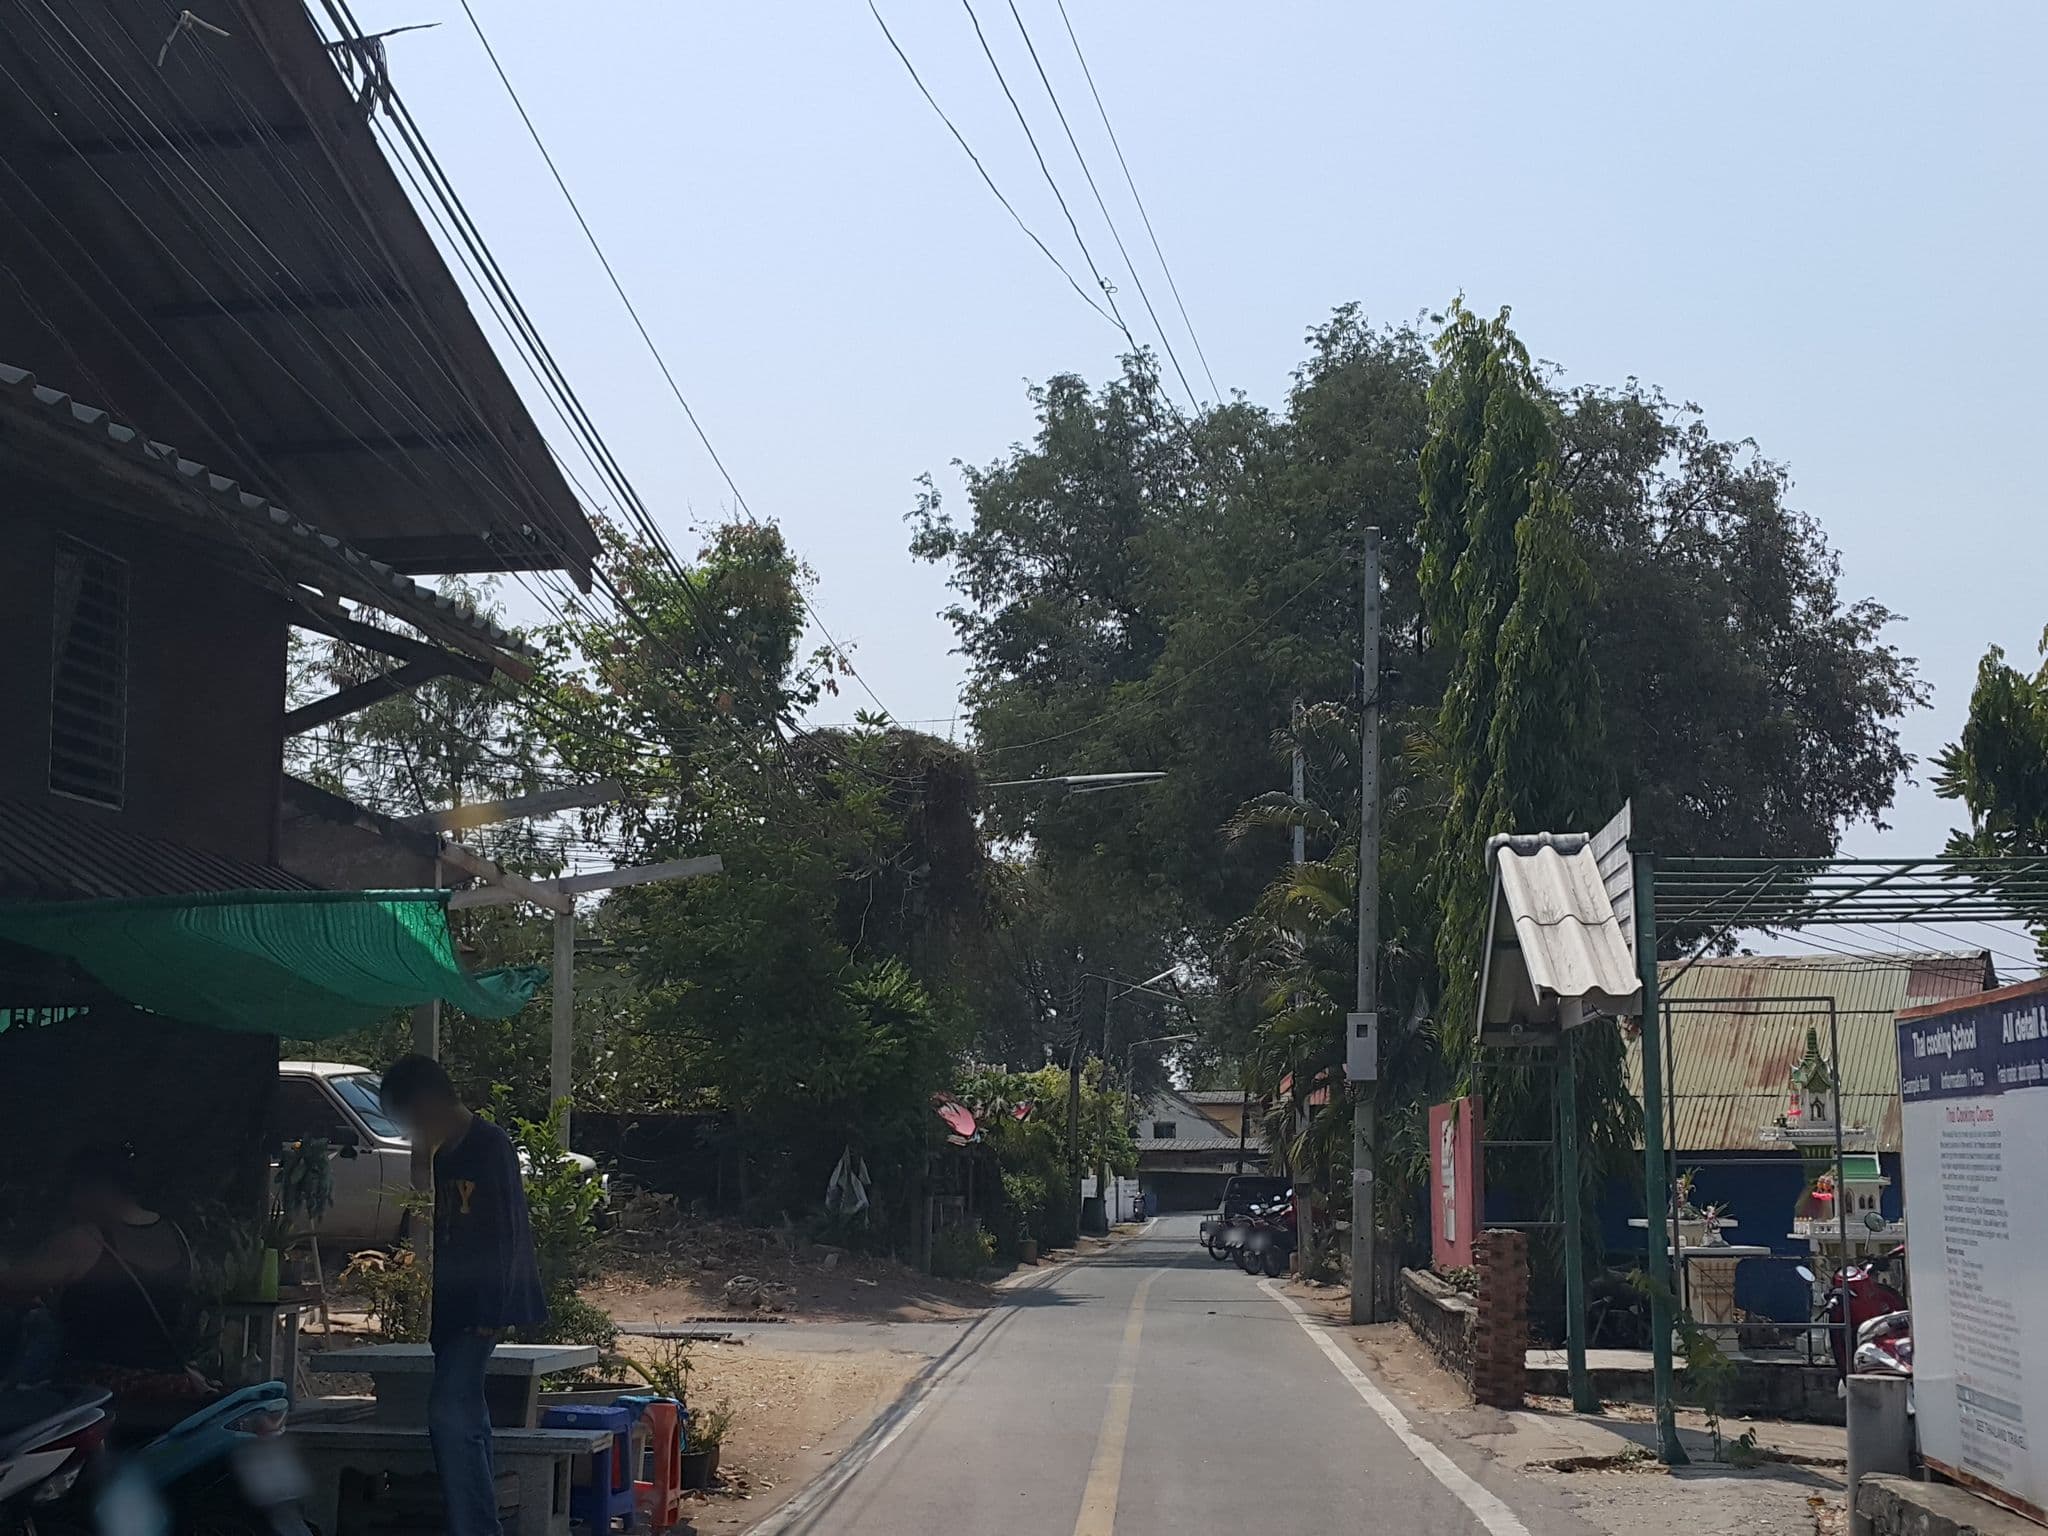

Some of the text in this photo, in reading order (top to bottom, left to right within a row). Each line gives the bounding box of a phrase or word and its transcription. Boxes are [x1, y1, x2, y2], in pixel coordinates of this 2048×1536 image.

[1912, 1020, 1977, 1059] Thai cooking School
[2002, 1012, 2015, 1044] All
